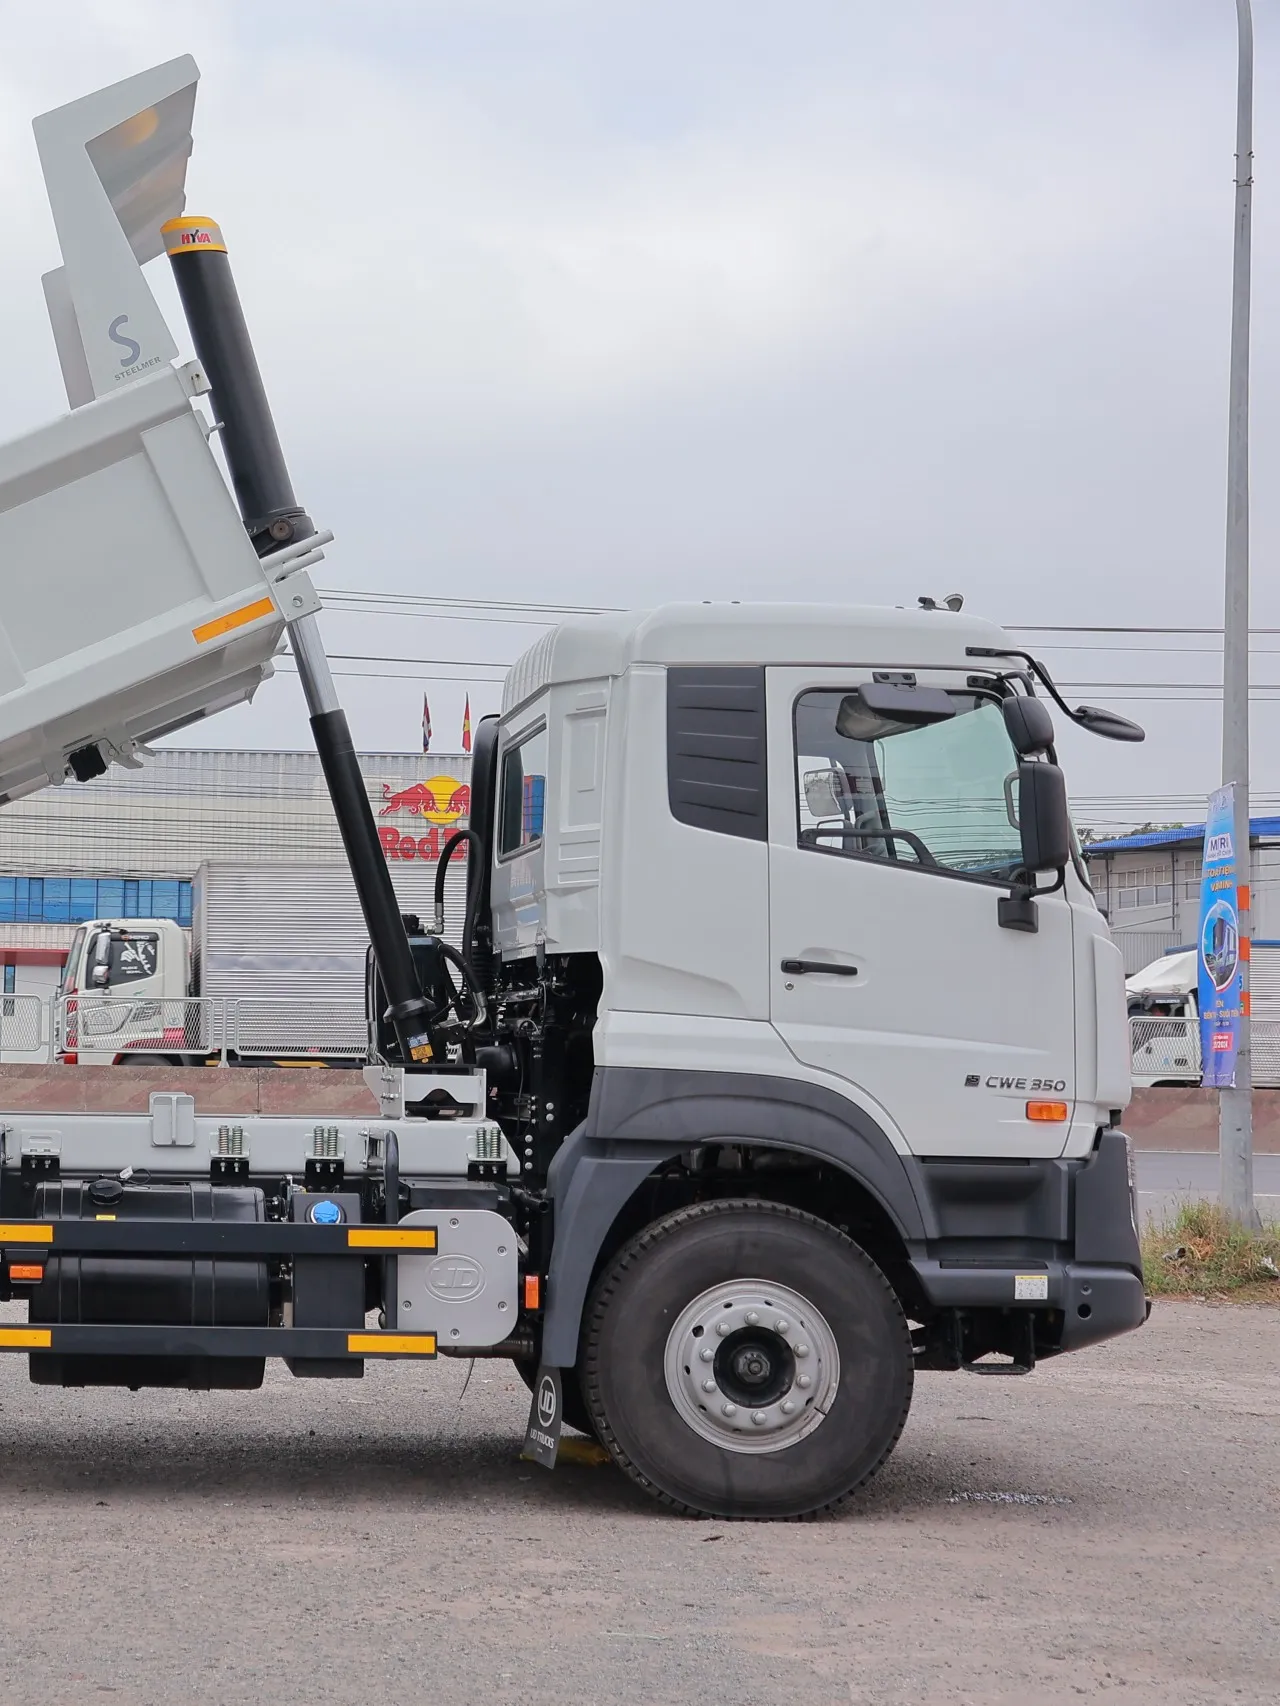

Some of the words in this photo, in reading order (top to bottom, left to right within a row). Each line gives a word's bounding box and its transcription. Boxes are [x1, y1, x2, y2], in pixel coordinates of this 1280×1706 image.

[181, 229, 211, 244] HYVA
[108, 314, 140, 368] S
[115, 356, 161, 381] STEELMER
[377, 826, 440, 861] Red
[985, 1076, 1027, 1090] CWE
[1030, 1078, 1066, 1092] 350
[530, 1428, 538, 1440] UD
[537, 1430, 554, 1449] TRUCKS
